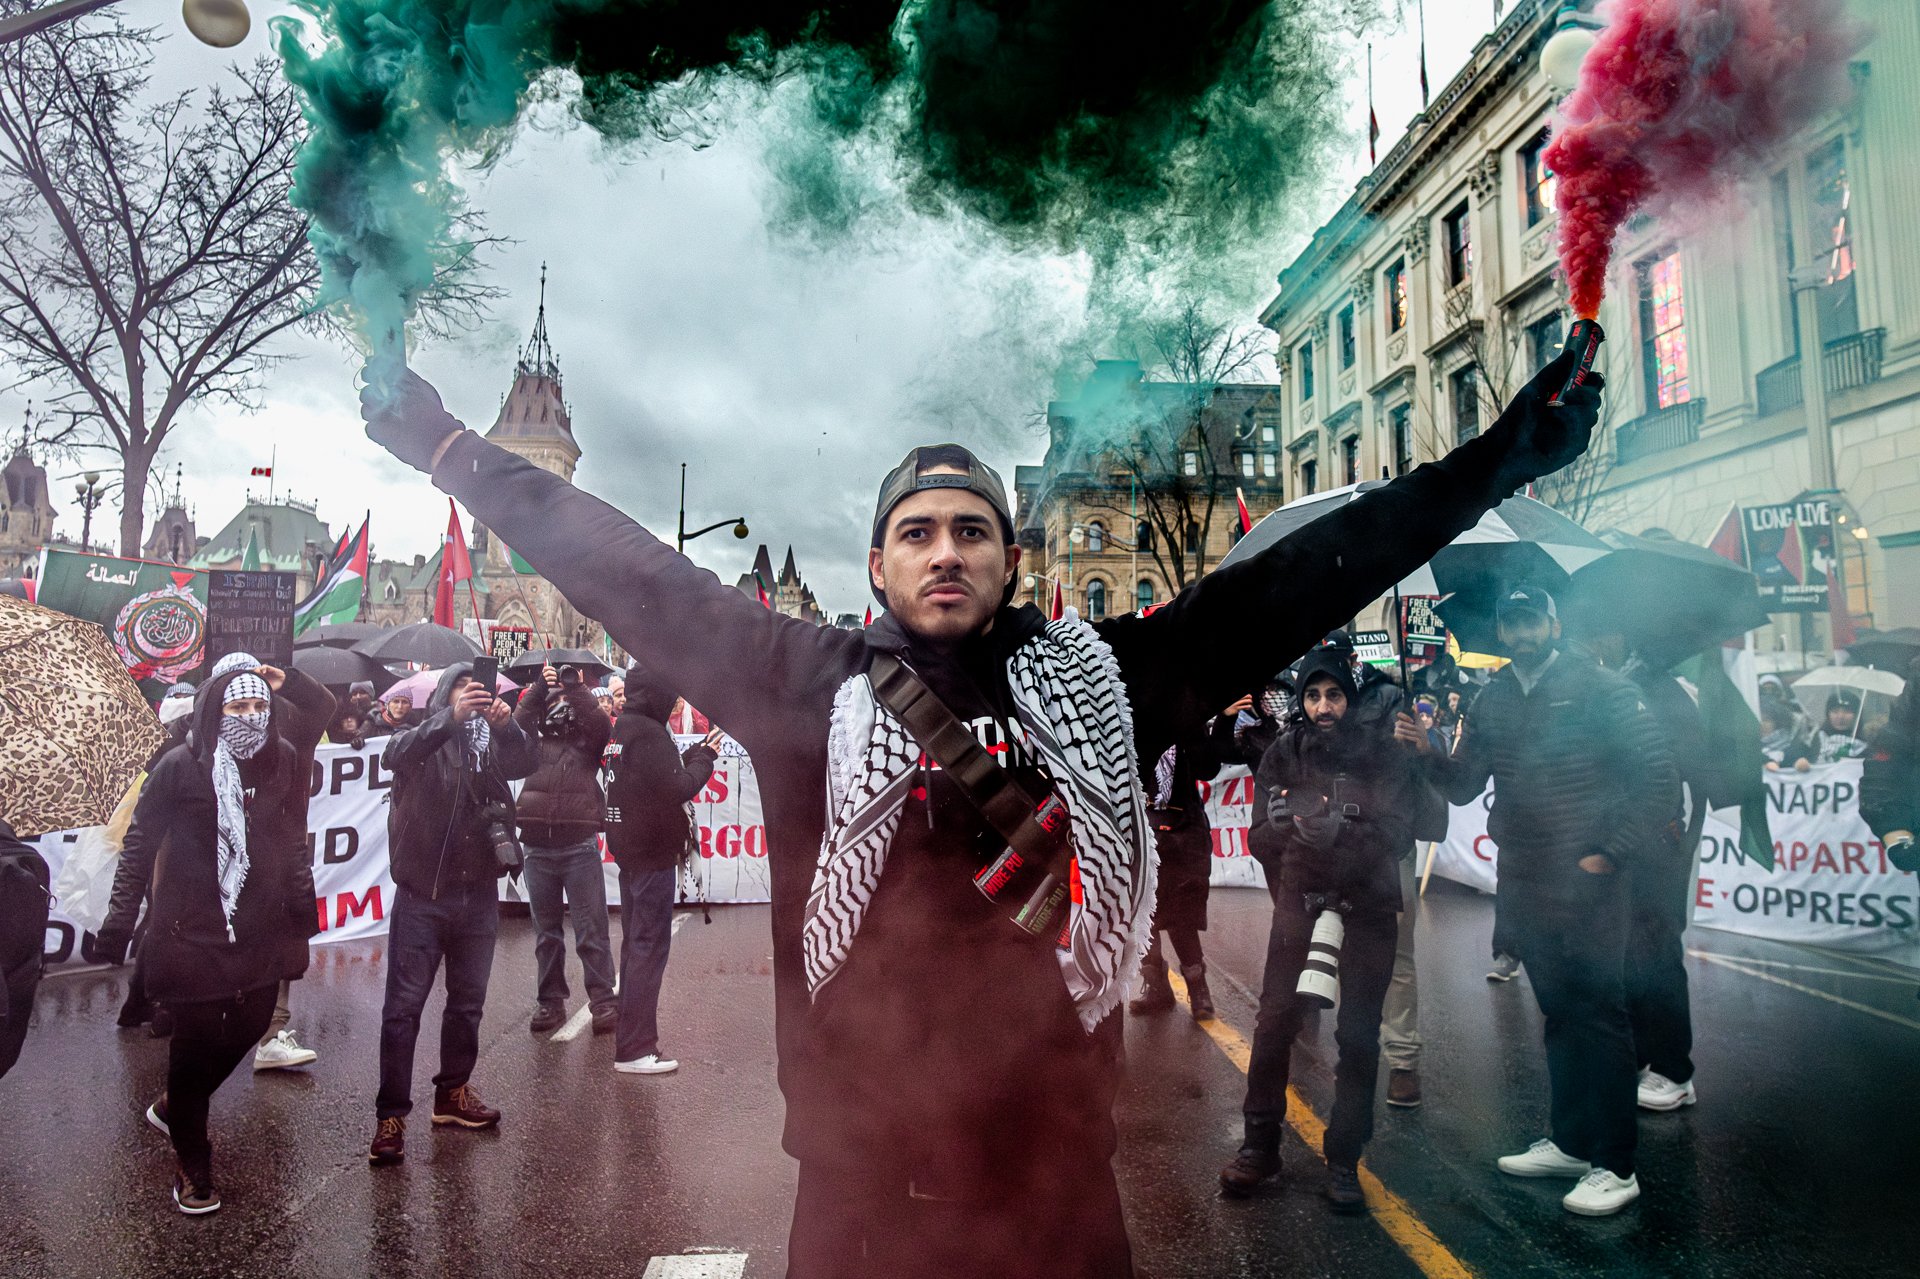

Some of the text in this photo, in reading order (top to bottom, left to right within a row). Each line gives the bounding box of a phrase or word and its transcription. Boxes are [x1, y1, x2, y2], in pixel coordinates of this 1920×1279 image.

[1749, 501, 1831, 532] LONG LIVE
[1408, 598, 1429, 607] FREE
[1407, 616, 1428, 626] FREE
[1413, 626, 1436, 635] LAND
[494, 631, 527, 641] FREE THE
[1356, 633, 1389, 644] STAND
[495, 641, 523, 649] PEOPLE
[493, 649, 512, 657] FREE
[983, 867, 1011, 896] WIRE
